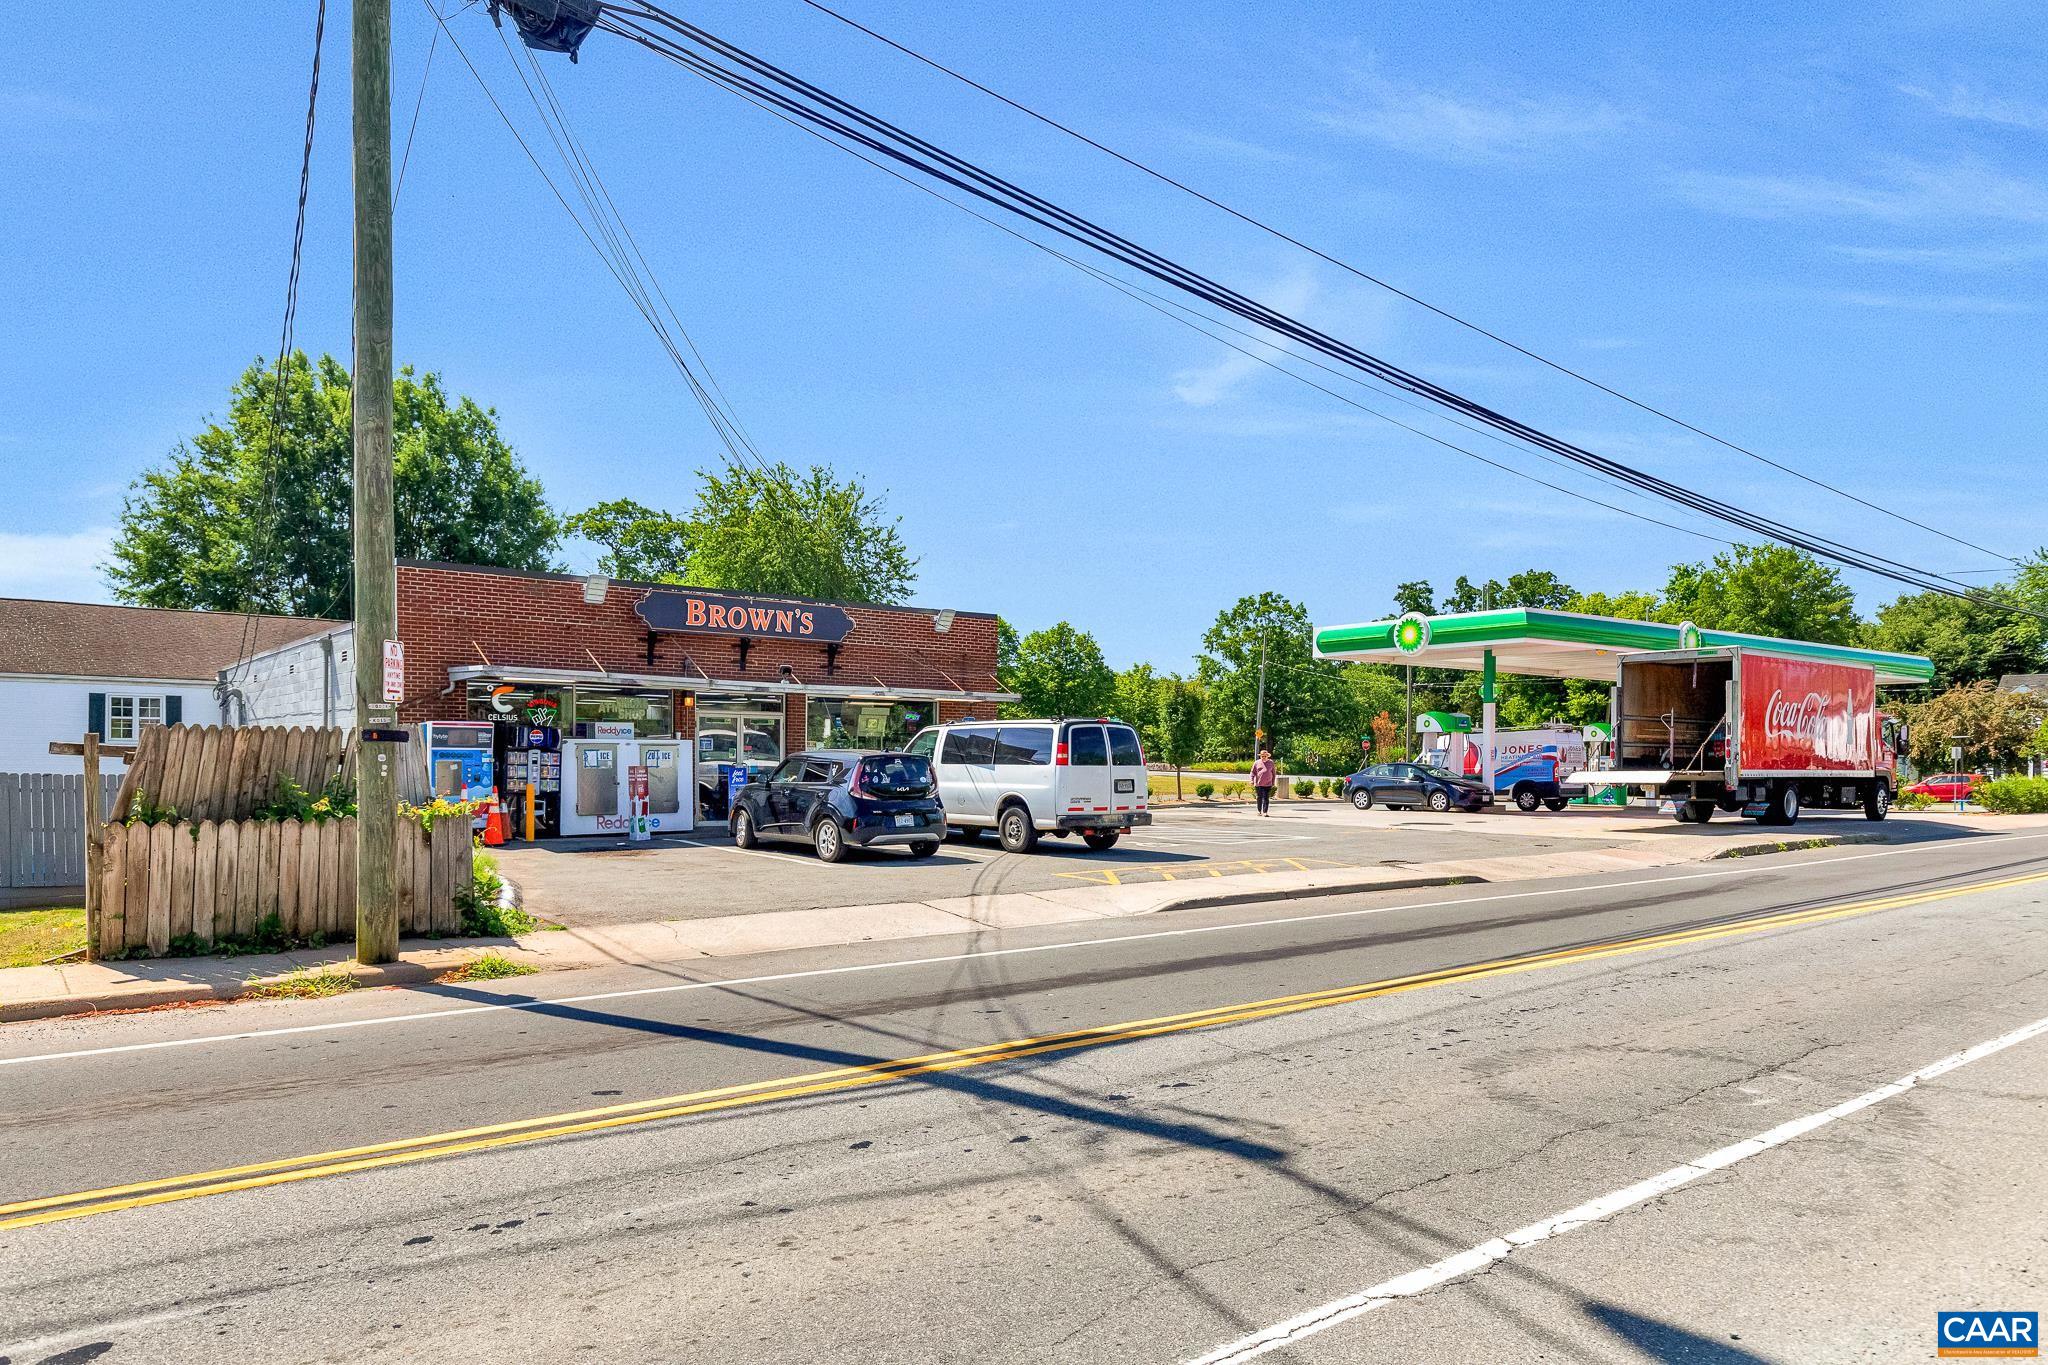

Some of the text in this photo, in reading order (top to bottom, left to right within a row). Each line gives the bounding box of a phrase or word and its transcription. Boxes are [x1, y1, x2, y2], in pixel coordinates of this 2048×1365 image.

[685, 598, 814, 635] BROWN'S
[390, 645, 398, 657] NO
[487, 713, 518, 721] CELSIUS
[1501, 744, 1543, 755] JONES
[599, 752, 610, 760] ICE
[661, 752, 671, 760] ICE
